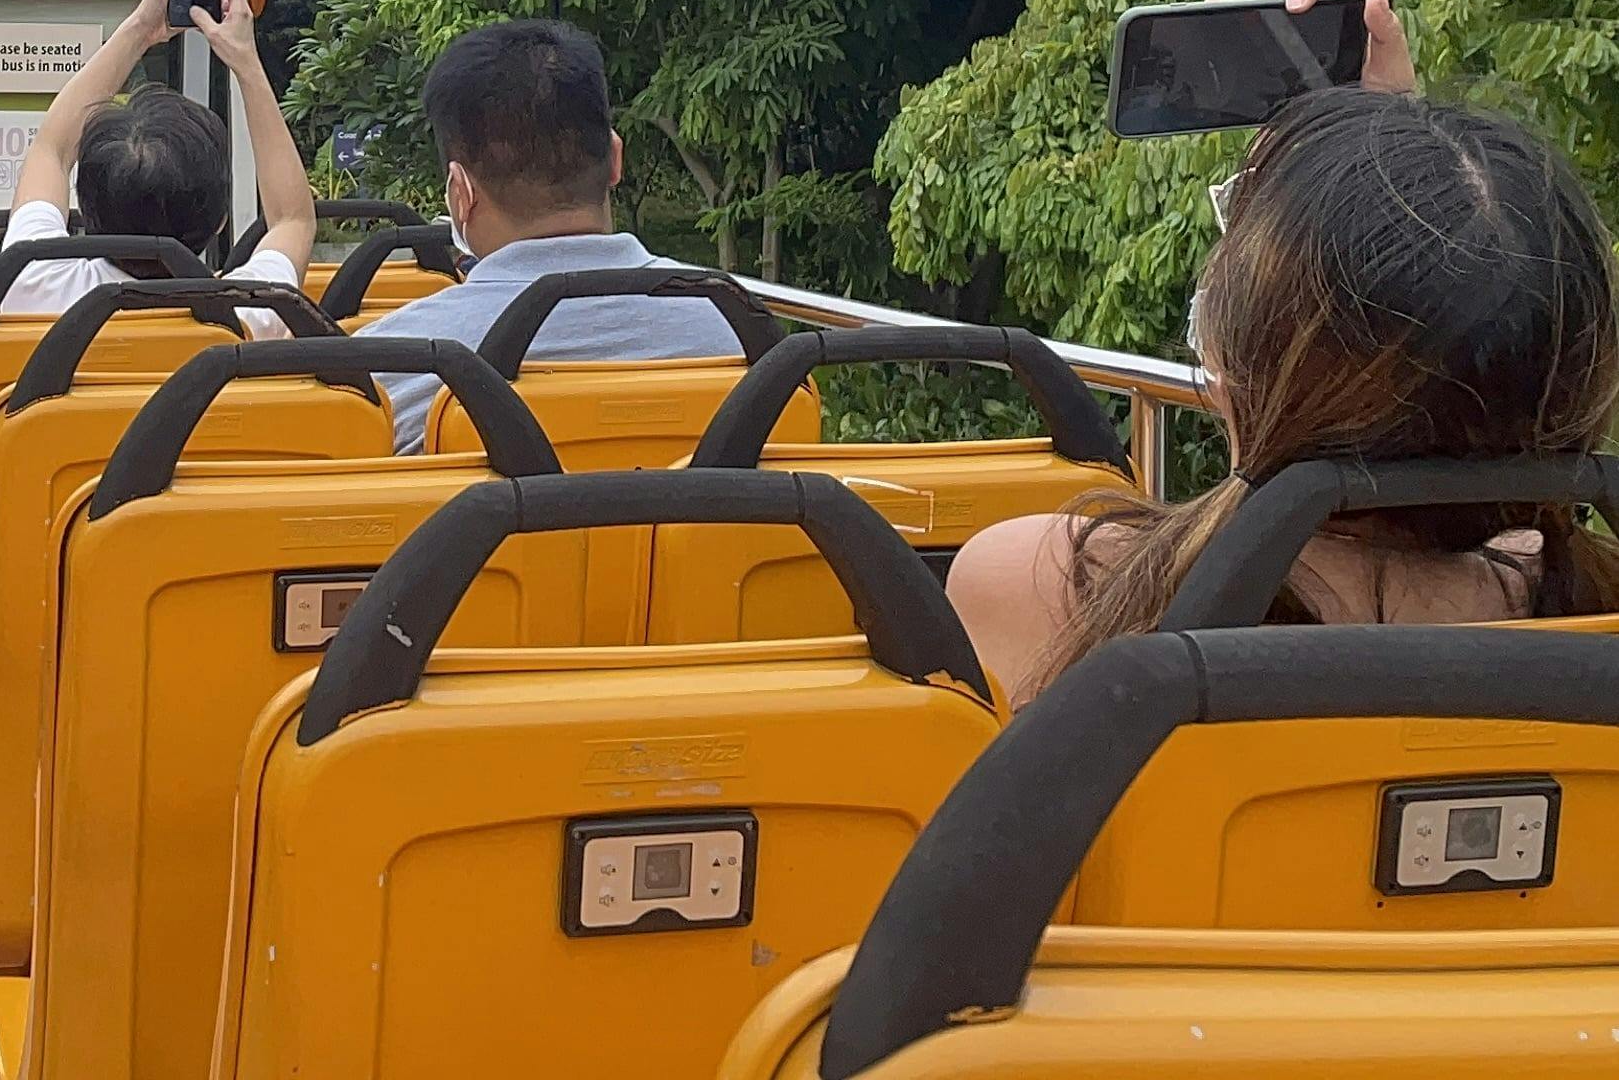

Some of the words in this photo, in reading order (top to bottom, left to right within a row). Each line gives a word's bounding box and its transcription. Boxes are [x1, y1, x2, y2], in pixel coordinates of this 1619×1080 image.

[23, 42, 38, 55] be
[41, 43, 81, 55] seated
[2, 59, 23, 72] bus
[26, 59, 35, 72] is
[39, 59, 49, 72] in
[53, 60, 85, 72] moti
